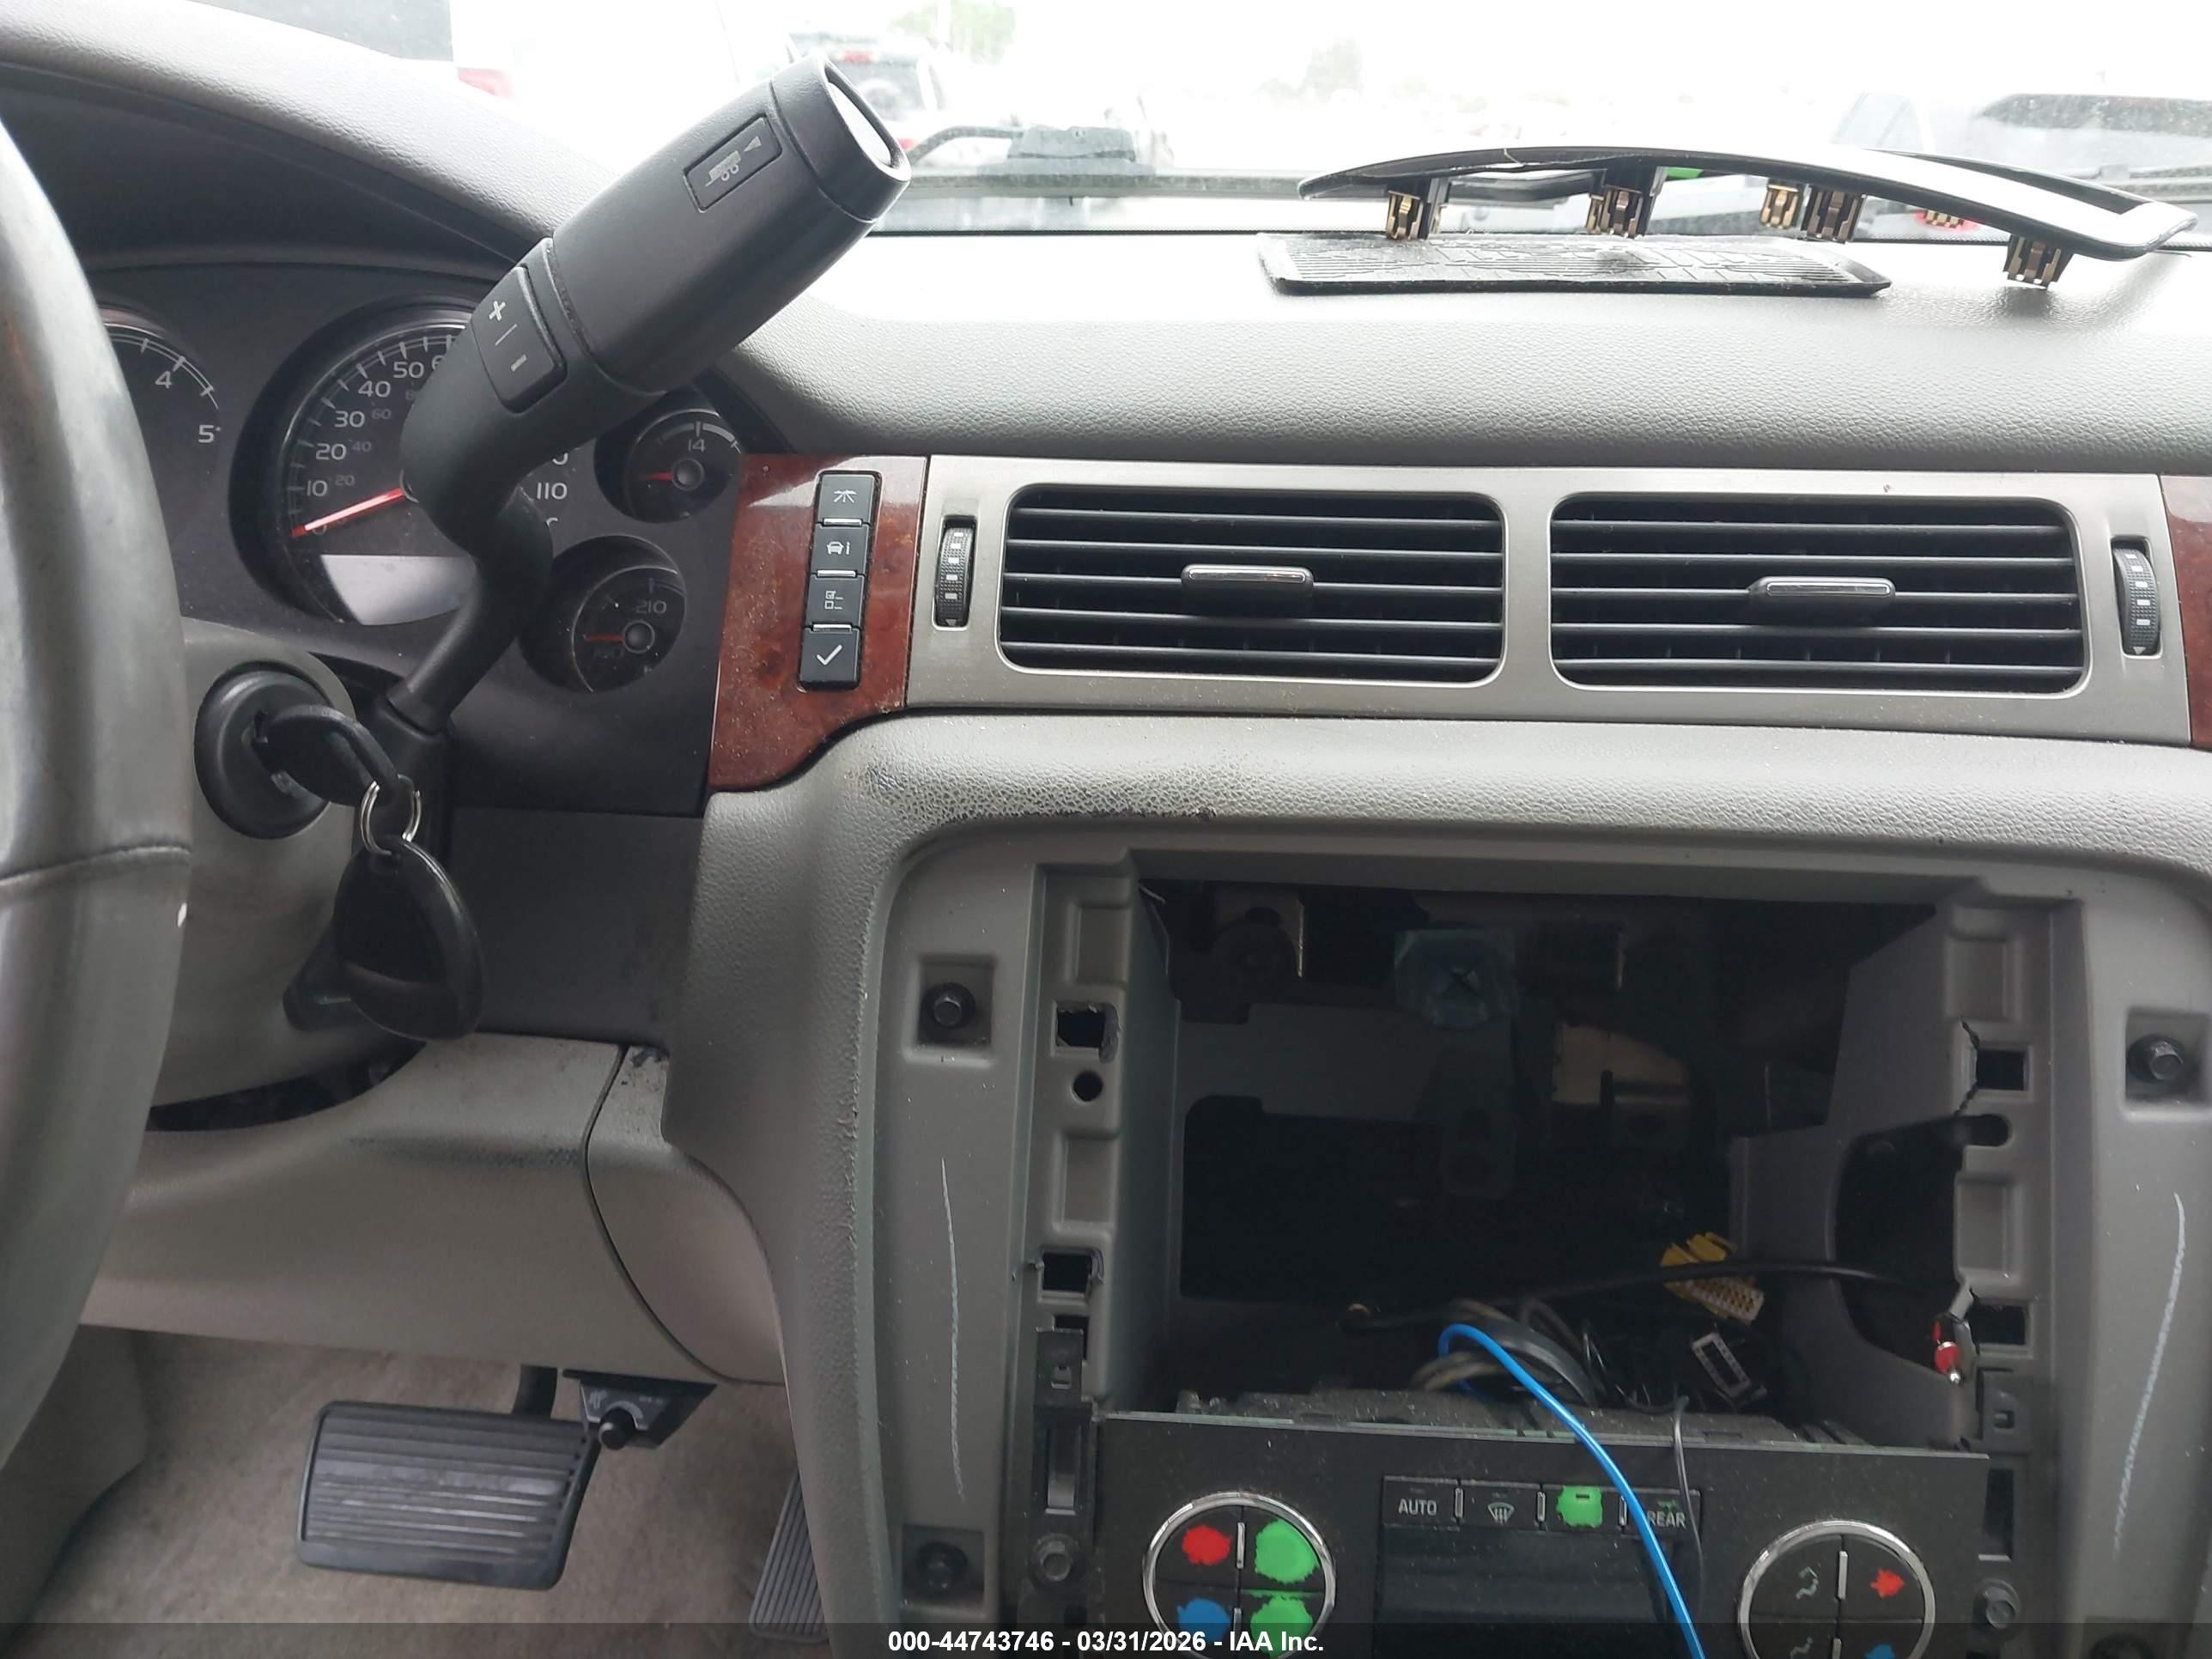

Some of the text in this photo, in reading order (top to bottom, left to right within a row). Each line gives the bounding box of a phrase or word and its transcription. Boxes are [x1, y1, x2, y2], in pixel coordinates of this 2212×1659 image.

[392, 361, 425, 379] 50
[155, 371, 173, 389] 4
[357, 380, 392, 398] 40
[334, 410, 366, 428] 30
[198, 424, 215, 443] 5
[315, 443, 347, 460] 20
[351, 441, 372, 453] 40
[688, 439, 706, 453] 14
[306, 480, 328, 497] 10
[335, 474, 356, 486] 20
[537, 482, 568, 500] 110
[635, 600, 667, 614] 210
[1398, 1498, 1437, 1516] AUTO
[1646, 1510, 1686, 1528] REAR
